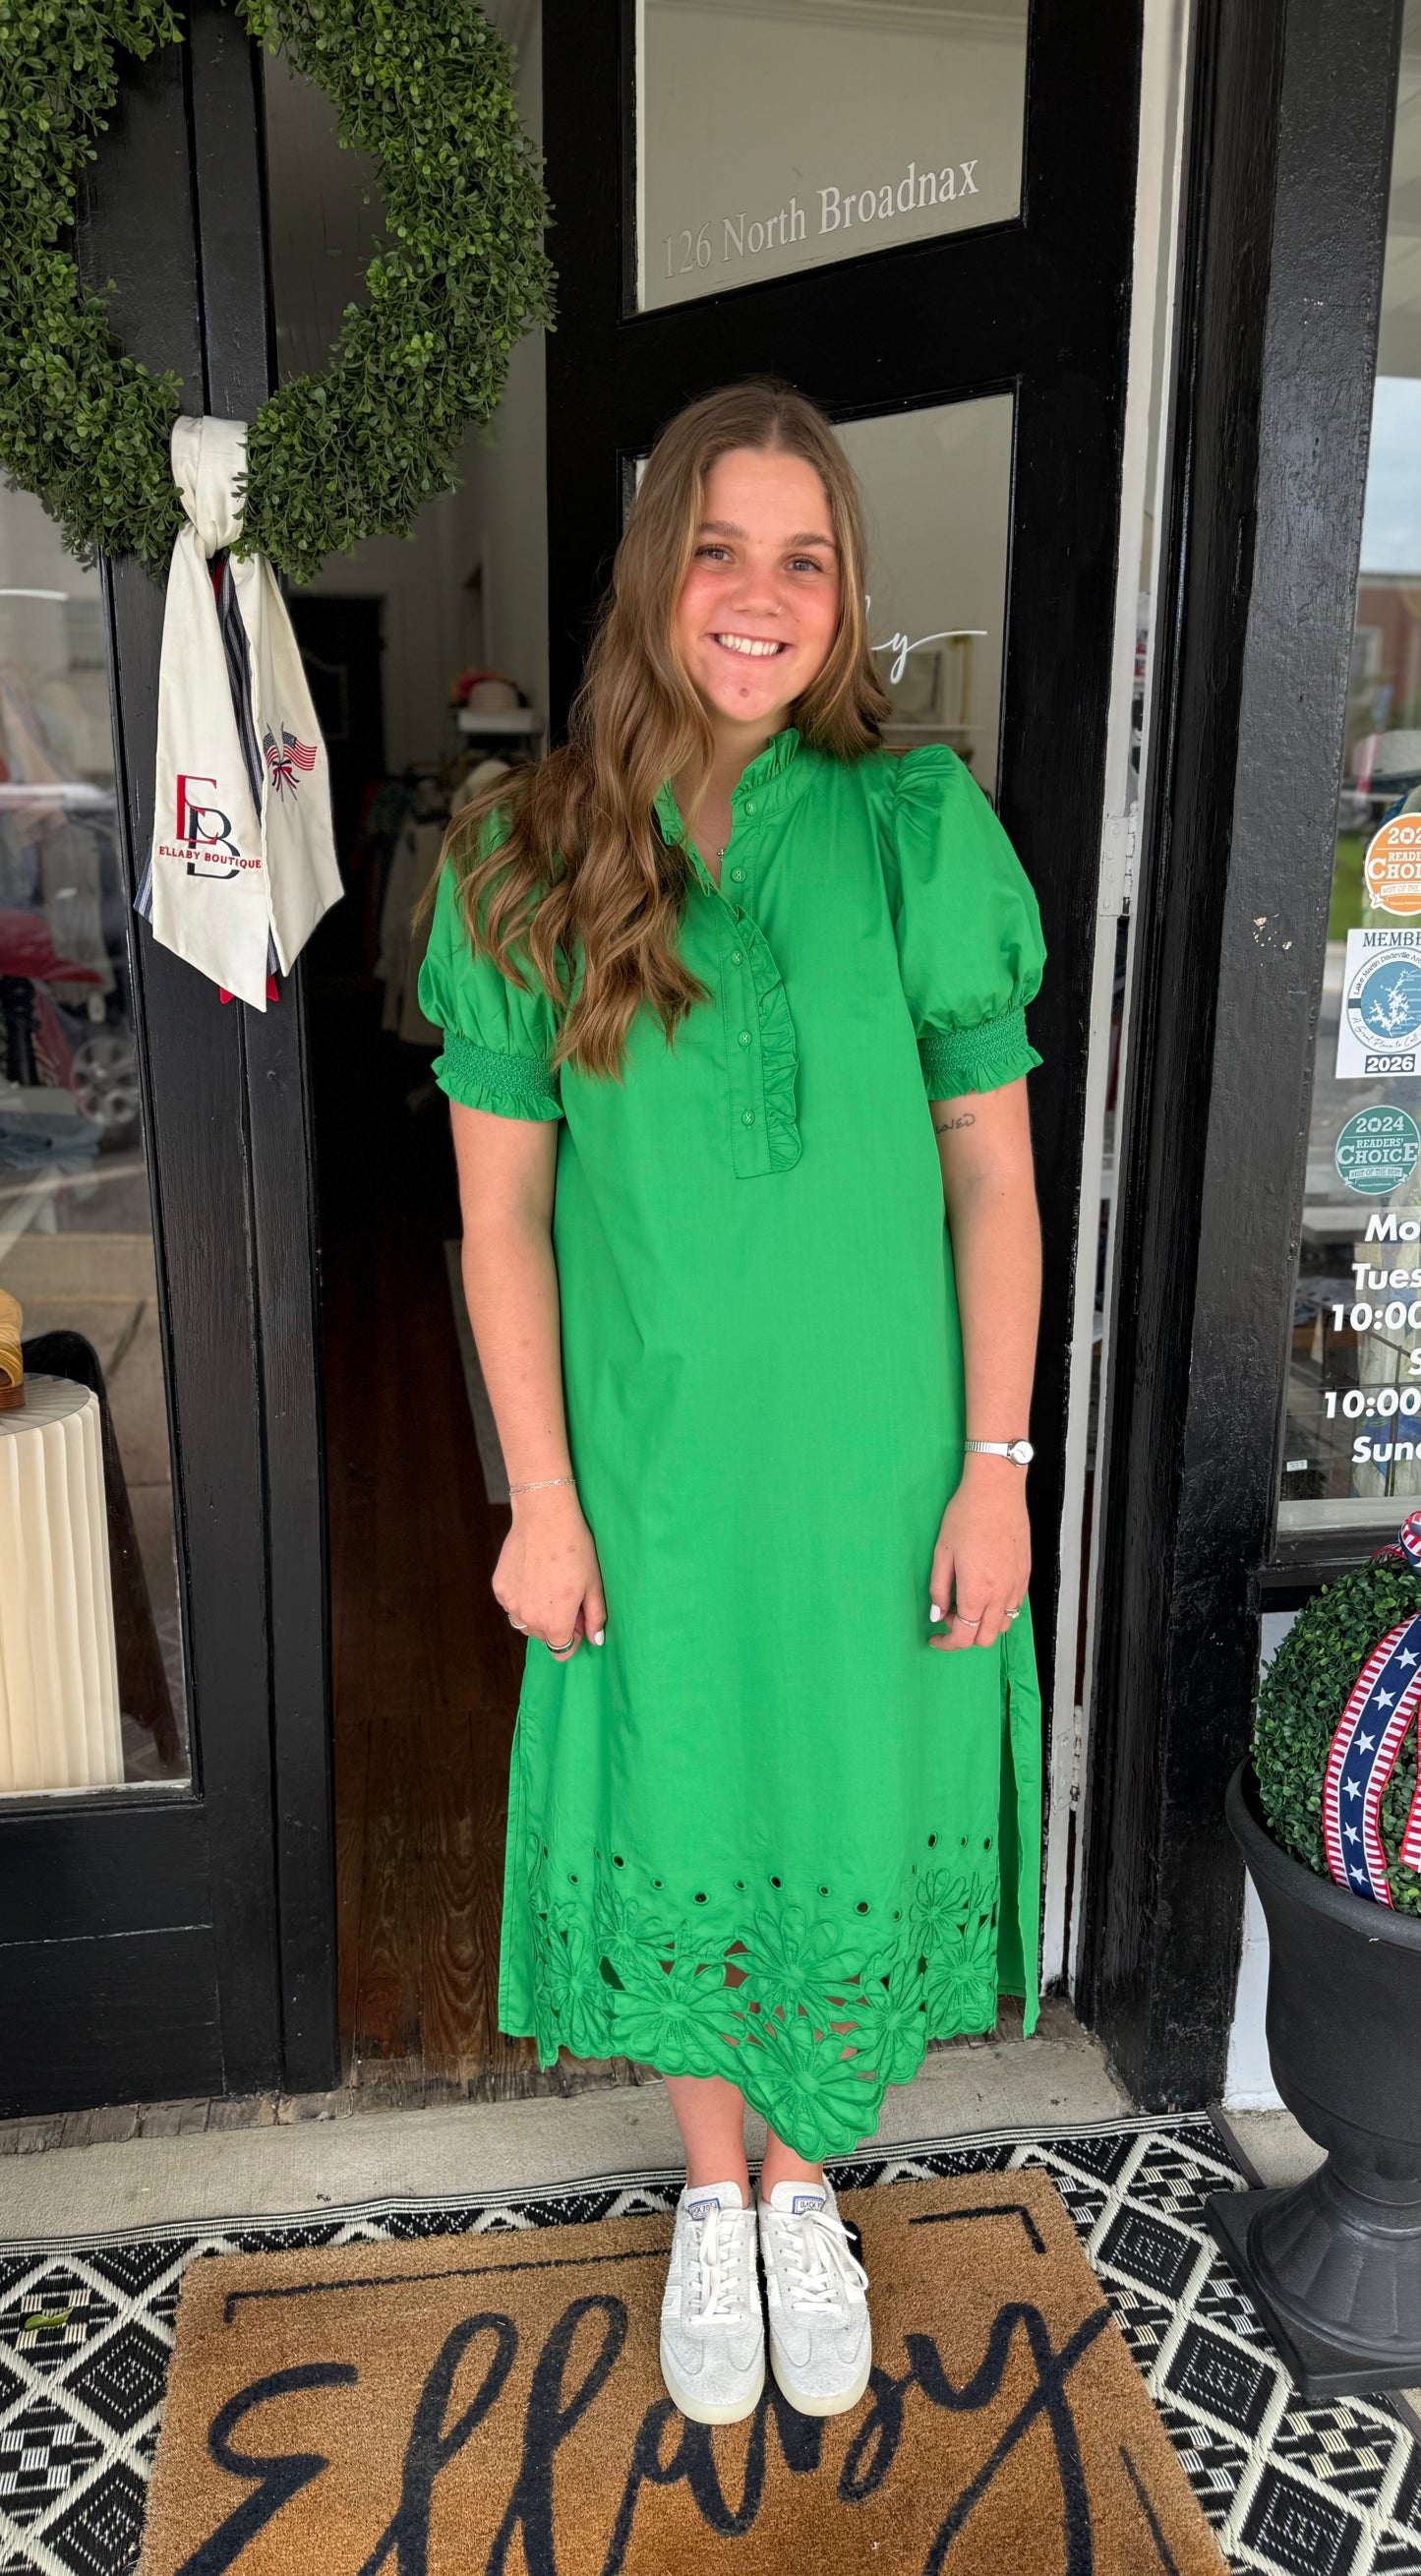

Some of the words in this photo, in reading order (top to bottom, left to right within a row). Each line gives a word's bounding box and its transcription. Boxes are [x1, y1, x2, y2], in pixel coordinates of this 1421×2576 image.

[662, 220, 712, 279] 126
[722, 196, 807, 263] North
[817, 159, 979, 235] Broadnax
[158, 845, 201, 860] ELLABY
[204, 852, 262, 869] BOUTIQUE
[1353, 978, 1365, 995] Lake
[1362, 959, 1381, 978] Martin
[1366, 1056, 1414, 1072] 2026
[1355, 1115, 1404, 1133] 2024
[1336, 1142, 1419, 1165] CHOICE
[1356, 1138, 1404, 1149] READERS'
[1325, 1388, 1421, 1418] 10:00
[1351, 1436, 1421, 1463] Sun
